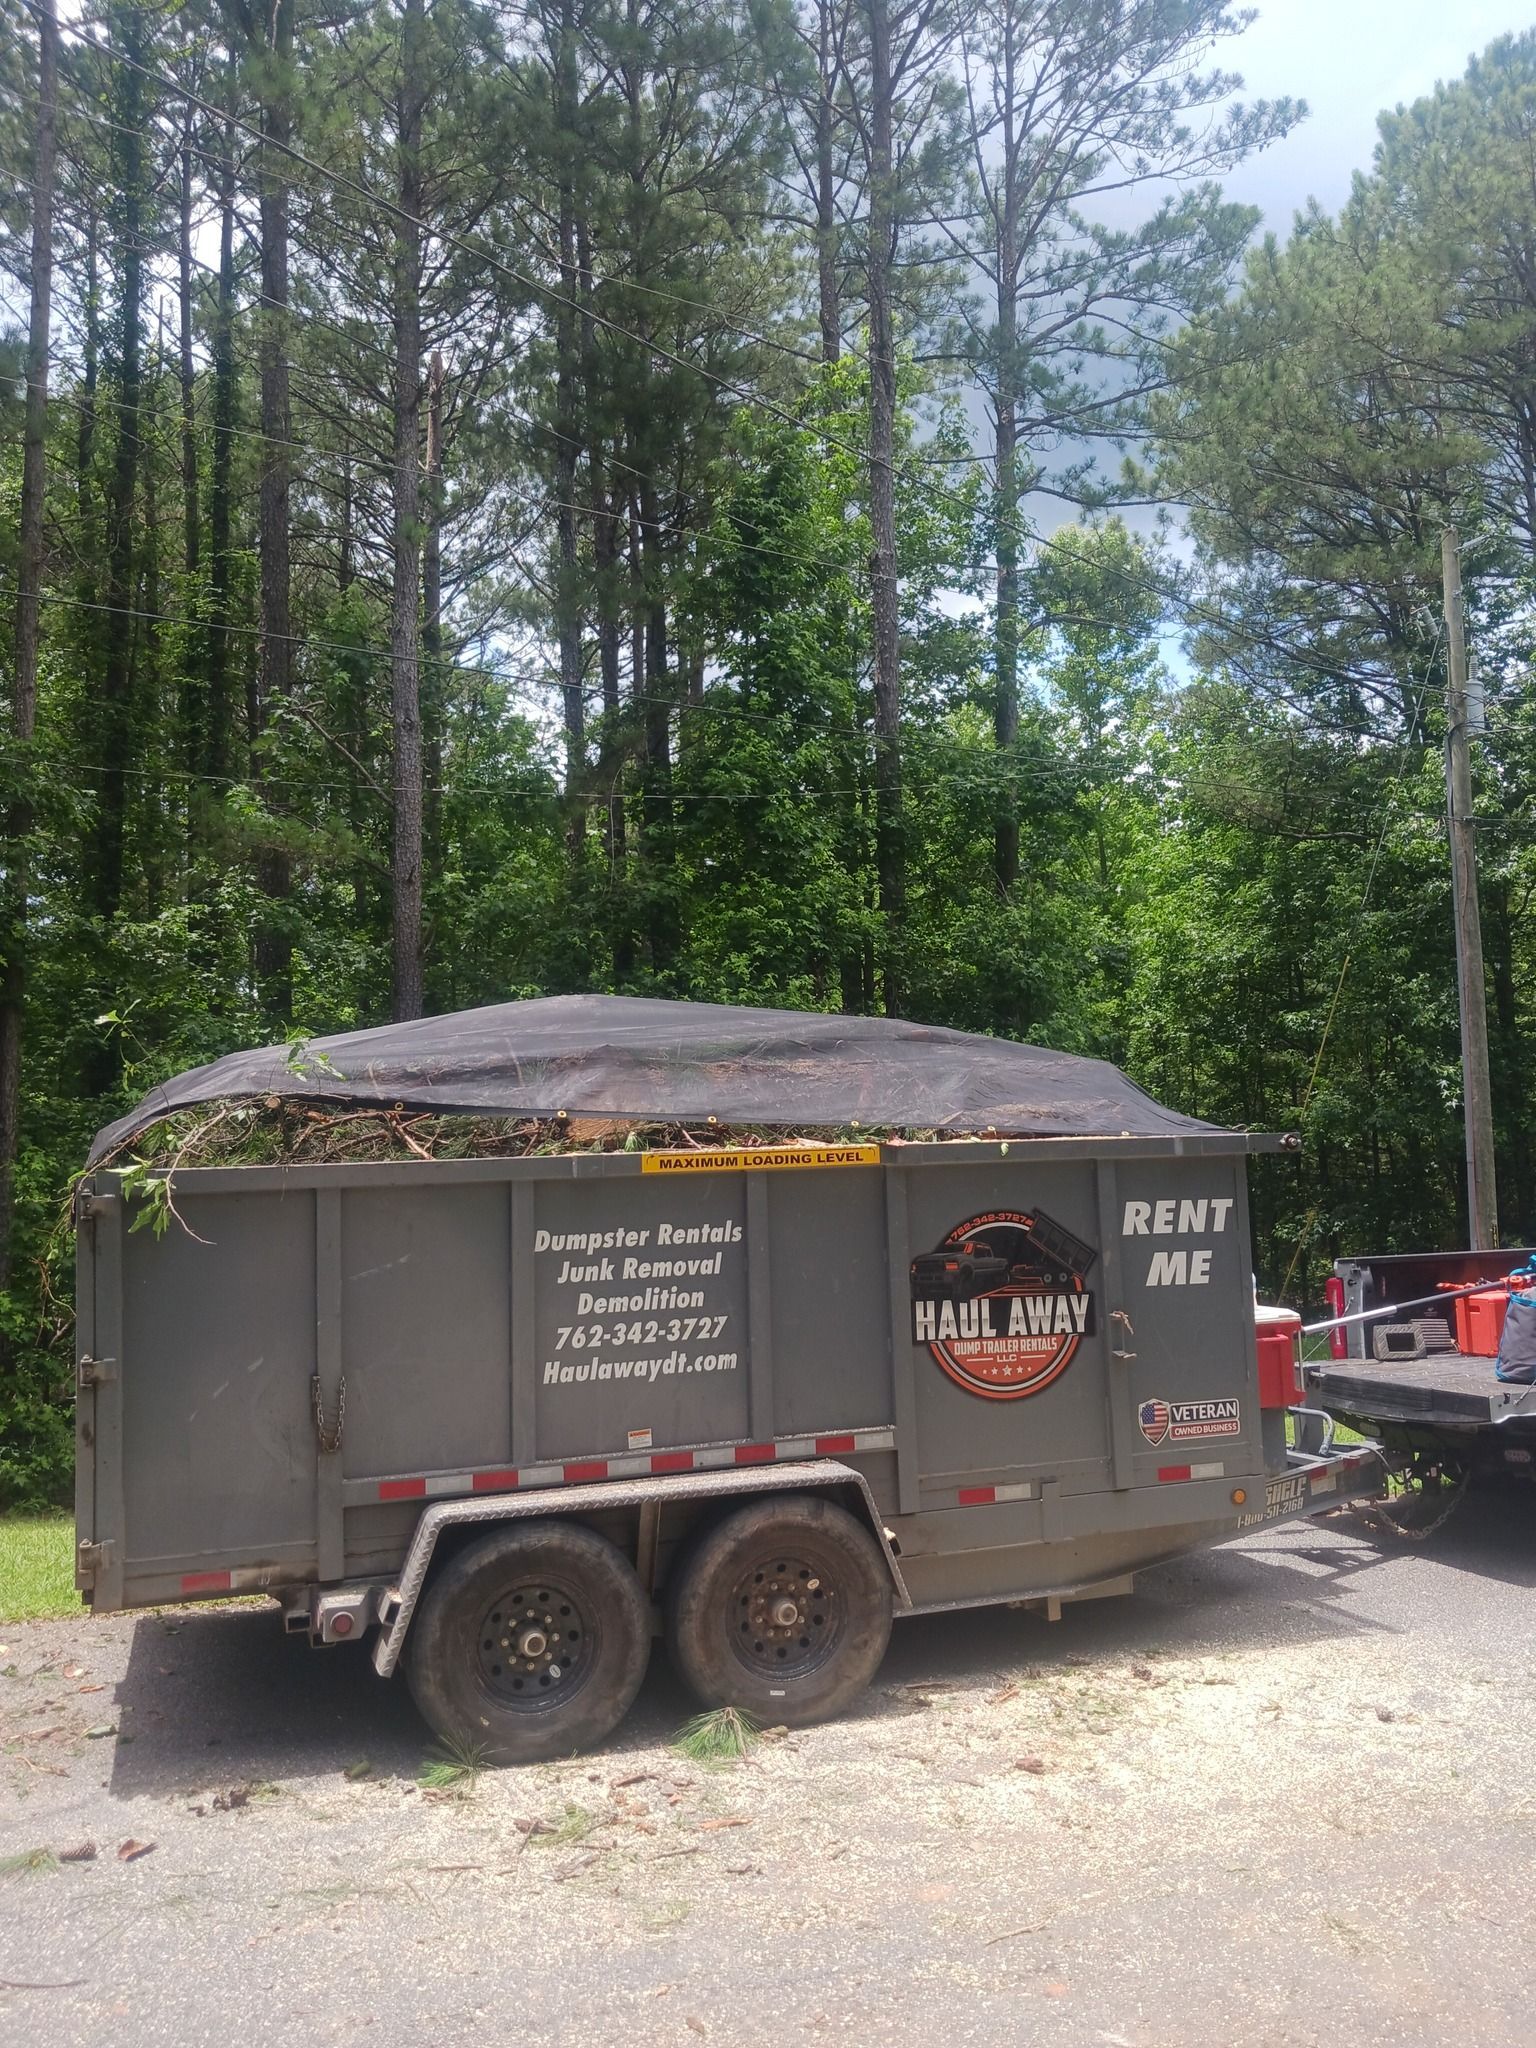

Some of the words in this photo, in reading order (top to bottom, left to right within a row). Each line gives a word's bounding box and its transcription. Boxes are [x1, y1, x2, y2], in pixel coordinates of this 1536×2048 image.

[659, 1156, 738, 1169] MAXIMUM
[743, 1153, 812, 1166] LOADING
[817, 1151, 863, 1163] LEVEL
[950, 1212, 1026, 1240] 762-342-3727
[1122, 1198, 1233, 1235] RENT
[534, 1228, 650, 1255] Dumpster
[657, 1220, 743, 1245] Rentals
[557, 1258, 614, 1284] Junk
[622, 1252, 722, 1280] Removal
[1146, 1249, 1213, 1286] ME
[577, 1286, 705, 1315] Demolition
[554, 1315, 728, 1350] 762-342-3727
[915, 1298, 997, 1341] HAUL
[1007, 1294, 1090, 1337] AWAY
[954, 1342, 981, 1356] DUMP
[982, 1339, 1019, 1353] TRAILER
[1020, 1337, 1058, 1351] RENTALS
[996, 1354, 1018, 1362] LLC
[543, 1351, 738, 1384] Haulawaydt.com
[1172, 1402, 1237, 1421] VETERAN
[1175, 1425, 1203, 1436] OWNED
[1203, 1422, 1237, 1434] BUSINESS
